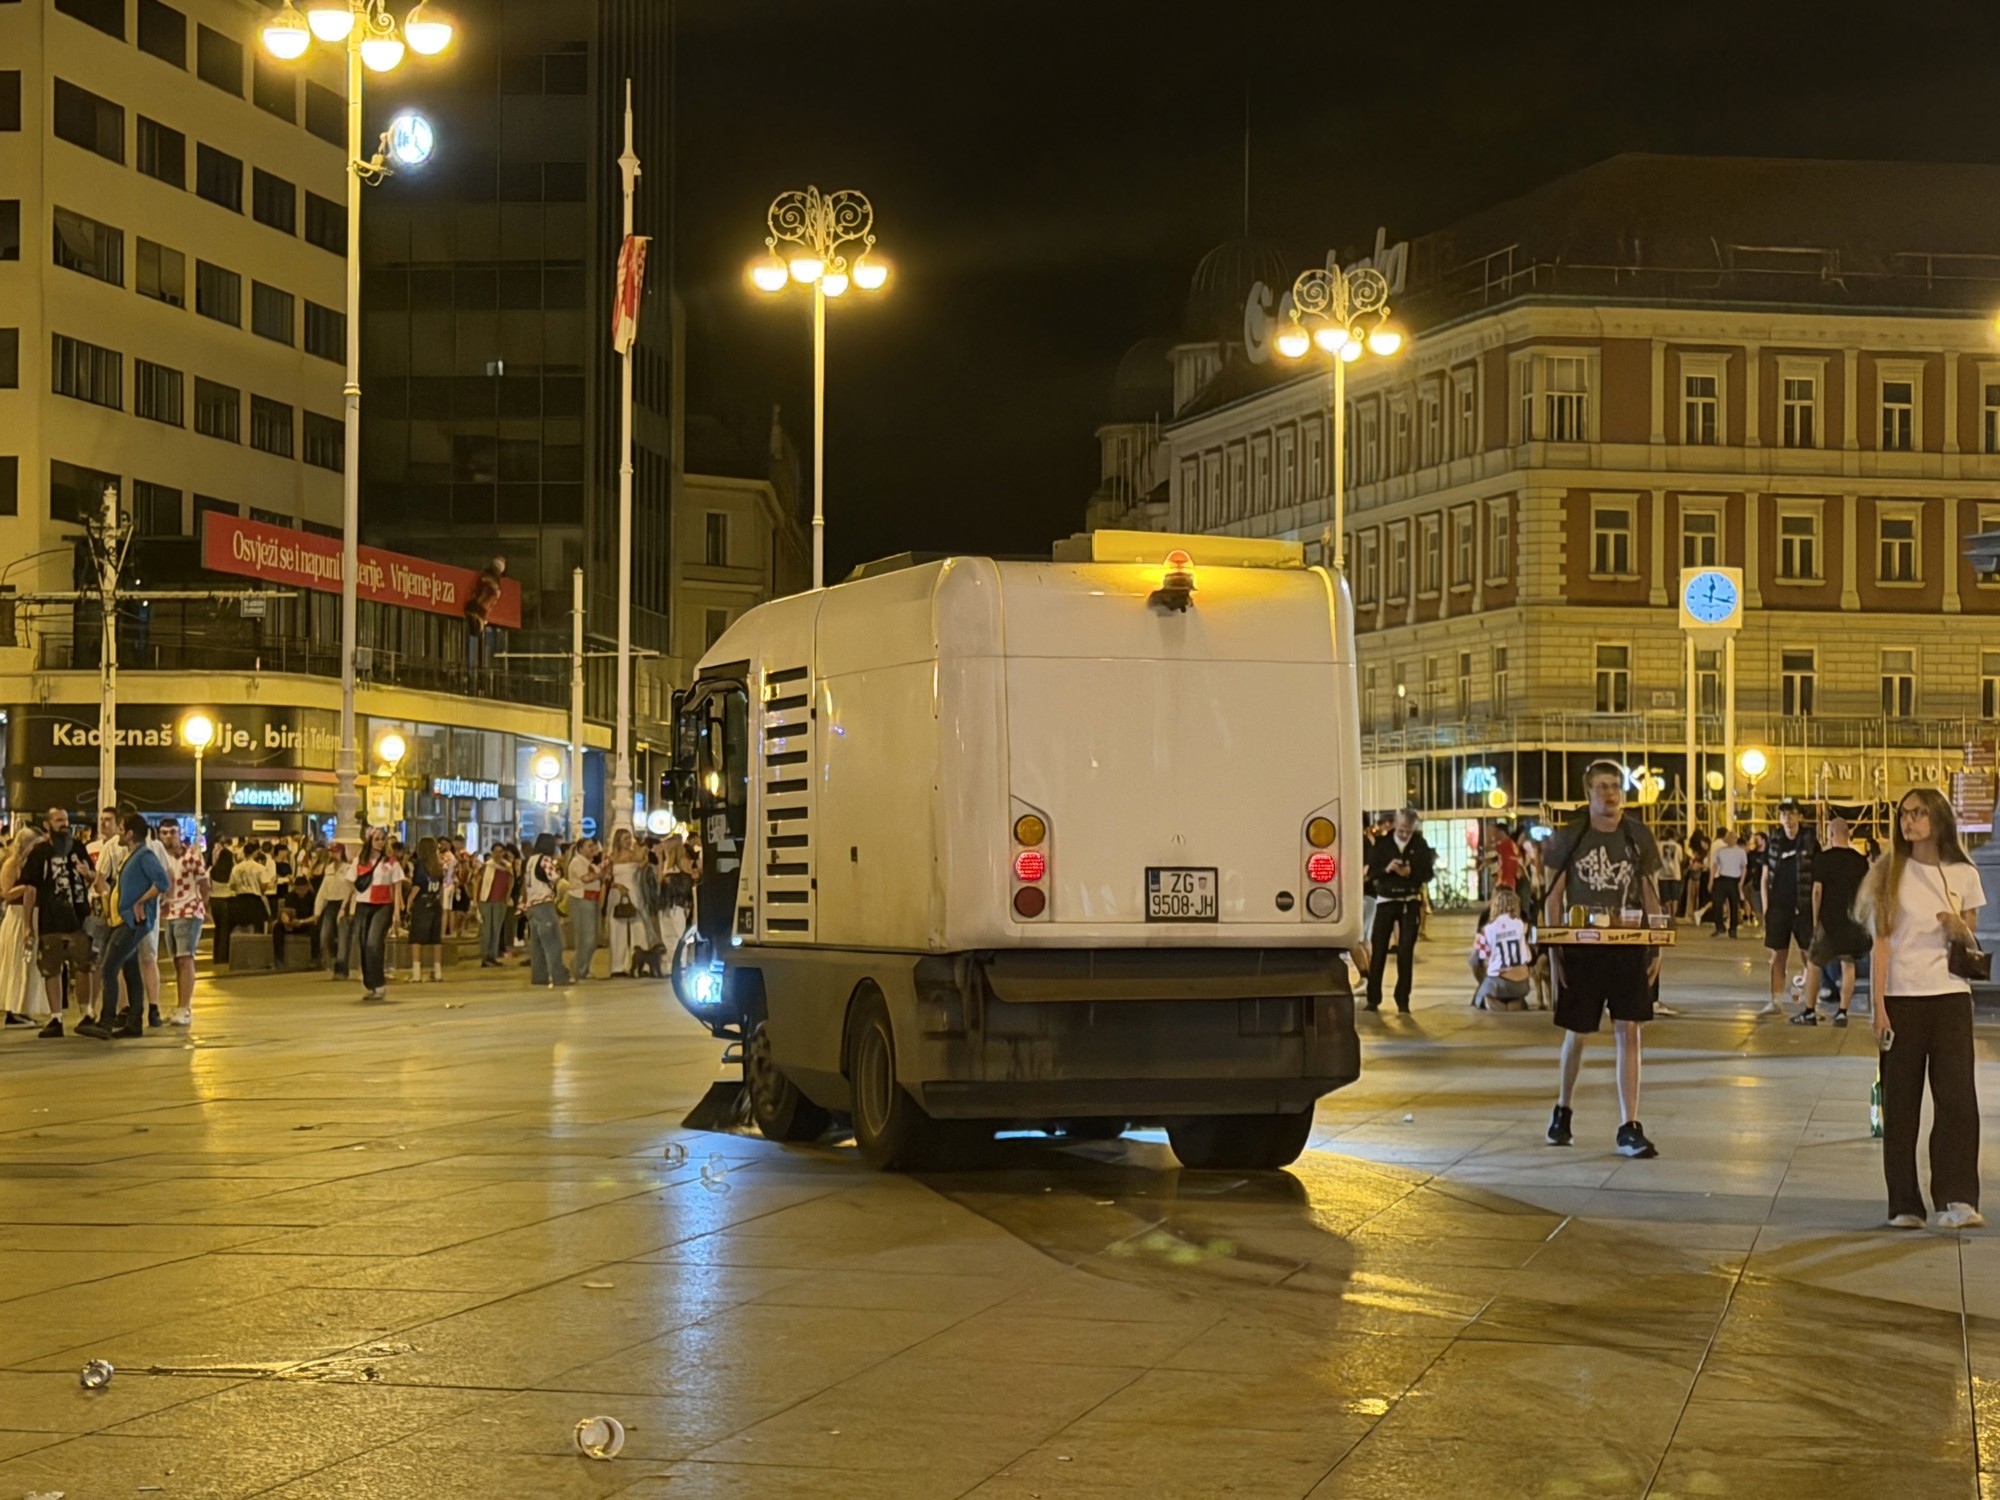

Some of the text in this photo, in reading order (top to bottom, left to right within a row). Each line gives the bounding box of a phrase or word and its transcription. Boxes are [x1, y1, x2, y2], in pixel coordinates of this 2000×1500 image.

[233, 530, 278, 570] Osvježi
[280, 550, 294, 571] se
[301, 550, 340, 582] napuni
[342, 552, 385, 593] erije.
[390, 563, 431, 599] Vrijeme
[432, 573, 441, 605] je
[443, 581, 455, 603] za
[114, 723, 173, 747] znaš
[265, 724, 308, 749] biraš
[1170, 873, 1194, 893] ZG
[1495, 939, 1521, 968] 10
